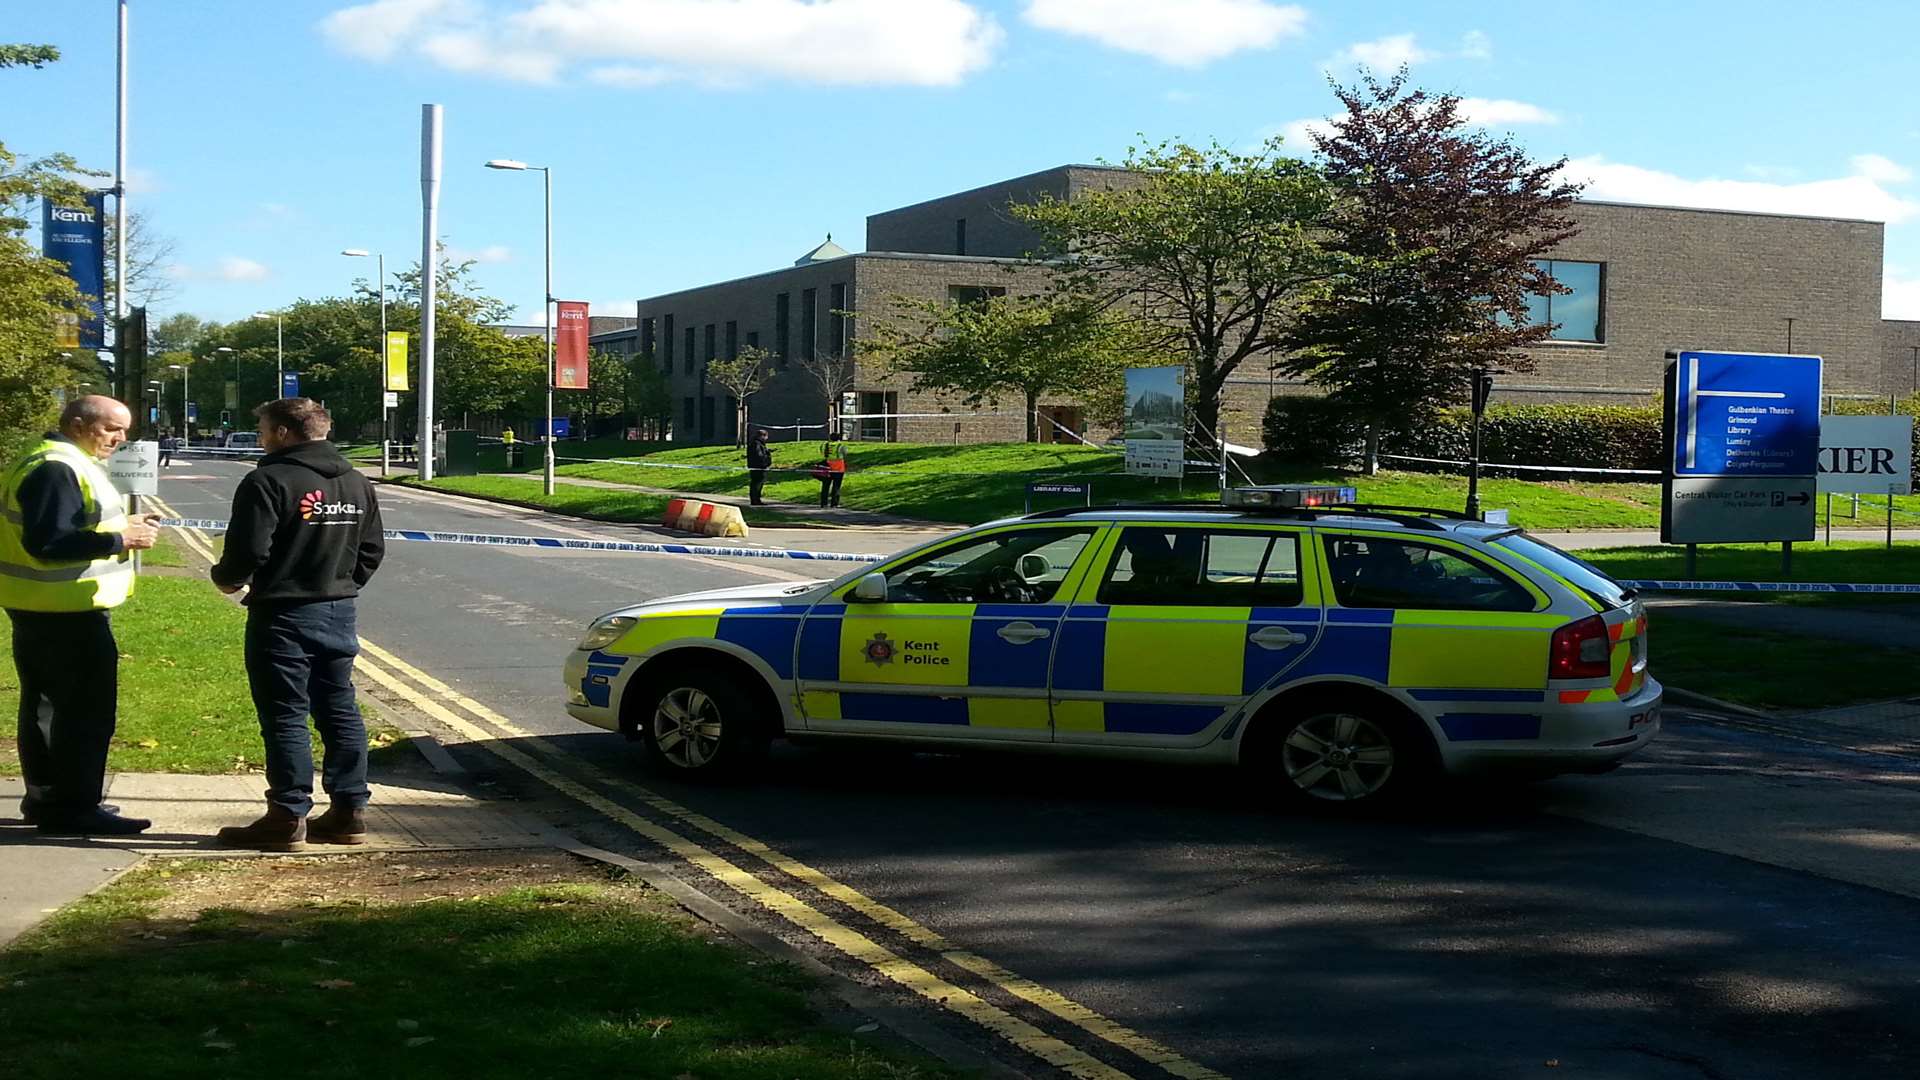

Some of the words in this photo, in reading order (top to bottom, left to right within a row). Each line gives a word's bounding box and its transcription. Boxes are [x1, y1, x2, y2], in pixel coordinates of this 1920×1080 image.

[1728, 406, 1766, 414] Gulbenkian
[1768, 406, 1794, 414] Theatre
[1728, 416, 1758, 424] Grimond
[1728, 426, 1752, 435] Library
[1675, 491, 1704, 499] Central
[488, 536, 504, 544] LINE
[506, 537, 530, 546] POLICE
[635, 544, 660, 552] POLICE
[904, 640, 940, 650] Kent
[904, 654, 950, 665] Police
